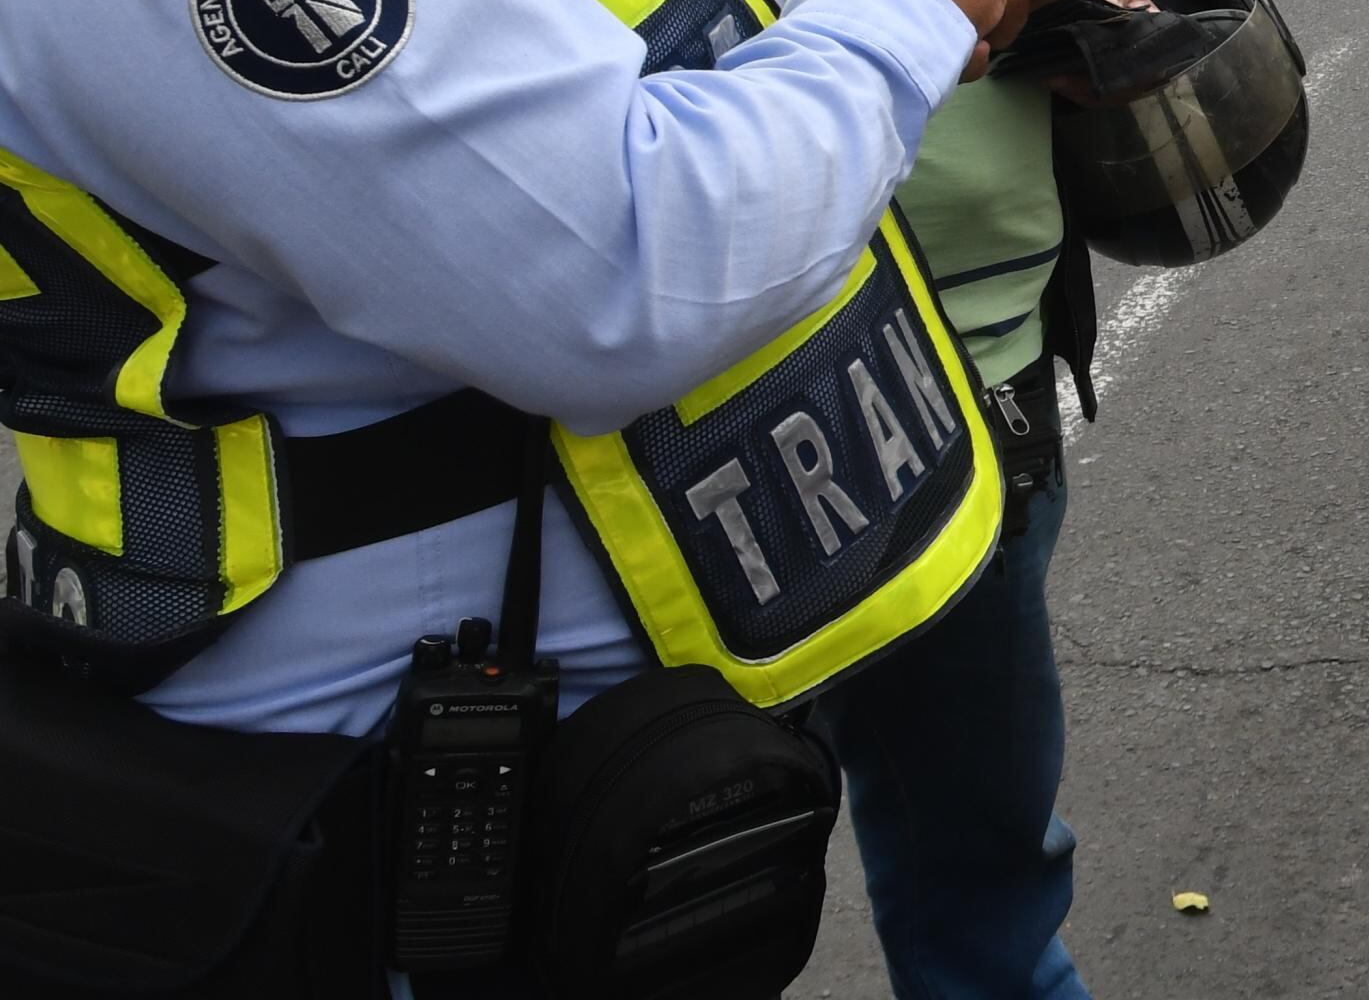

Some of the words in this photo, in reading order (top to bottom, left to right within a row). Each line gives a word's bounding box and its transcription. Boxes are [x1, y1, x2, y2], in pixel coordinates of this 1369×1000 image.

[335, 34, 389, 81] CALI
[686, 308, 956, 606] TRAN
[448, 703, 519, 714] MOTOROLA
